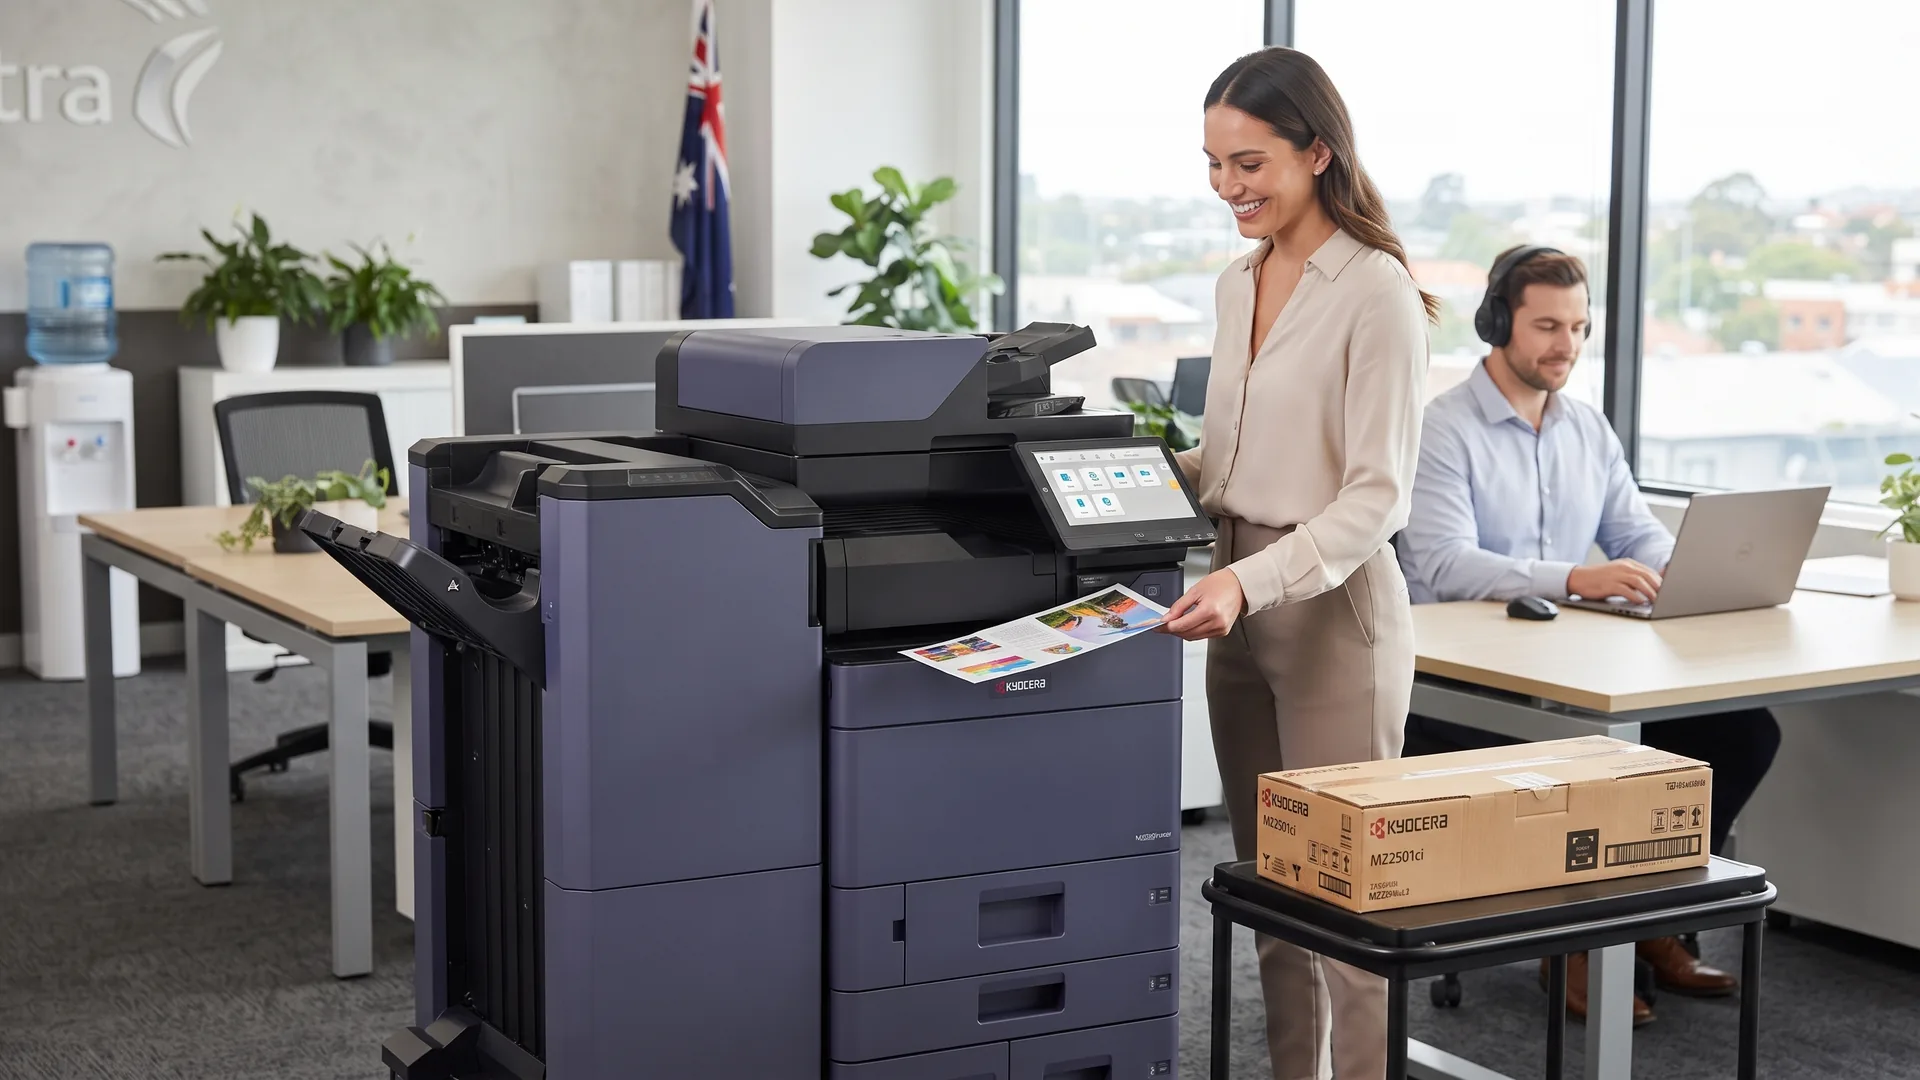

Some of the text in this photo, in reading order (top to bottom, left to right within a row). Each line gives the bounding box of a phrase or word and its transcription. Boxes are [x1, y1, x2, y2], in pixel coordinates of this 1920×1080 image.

[1006, 679, 1045, 692] KYOCERA
[1271, 793, 1309, 817] KYOCERA
[1263, 814, 1296, 836] MZ2501ci
[1387, 814, 1448, 835] KYOCERA
[1370, 848, 1424, 867] MZ2501ci
